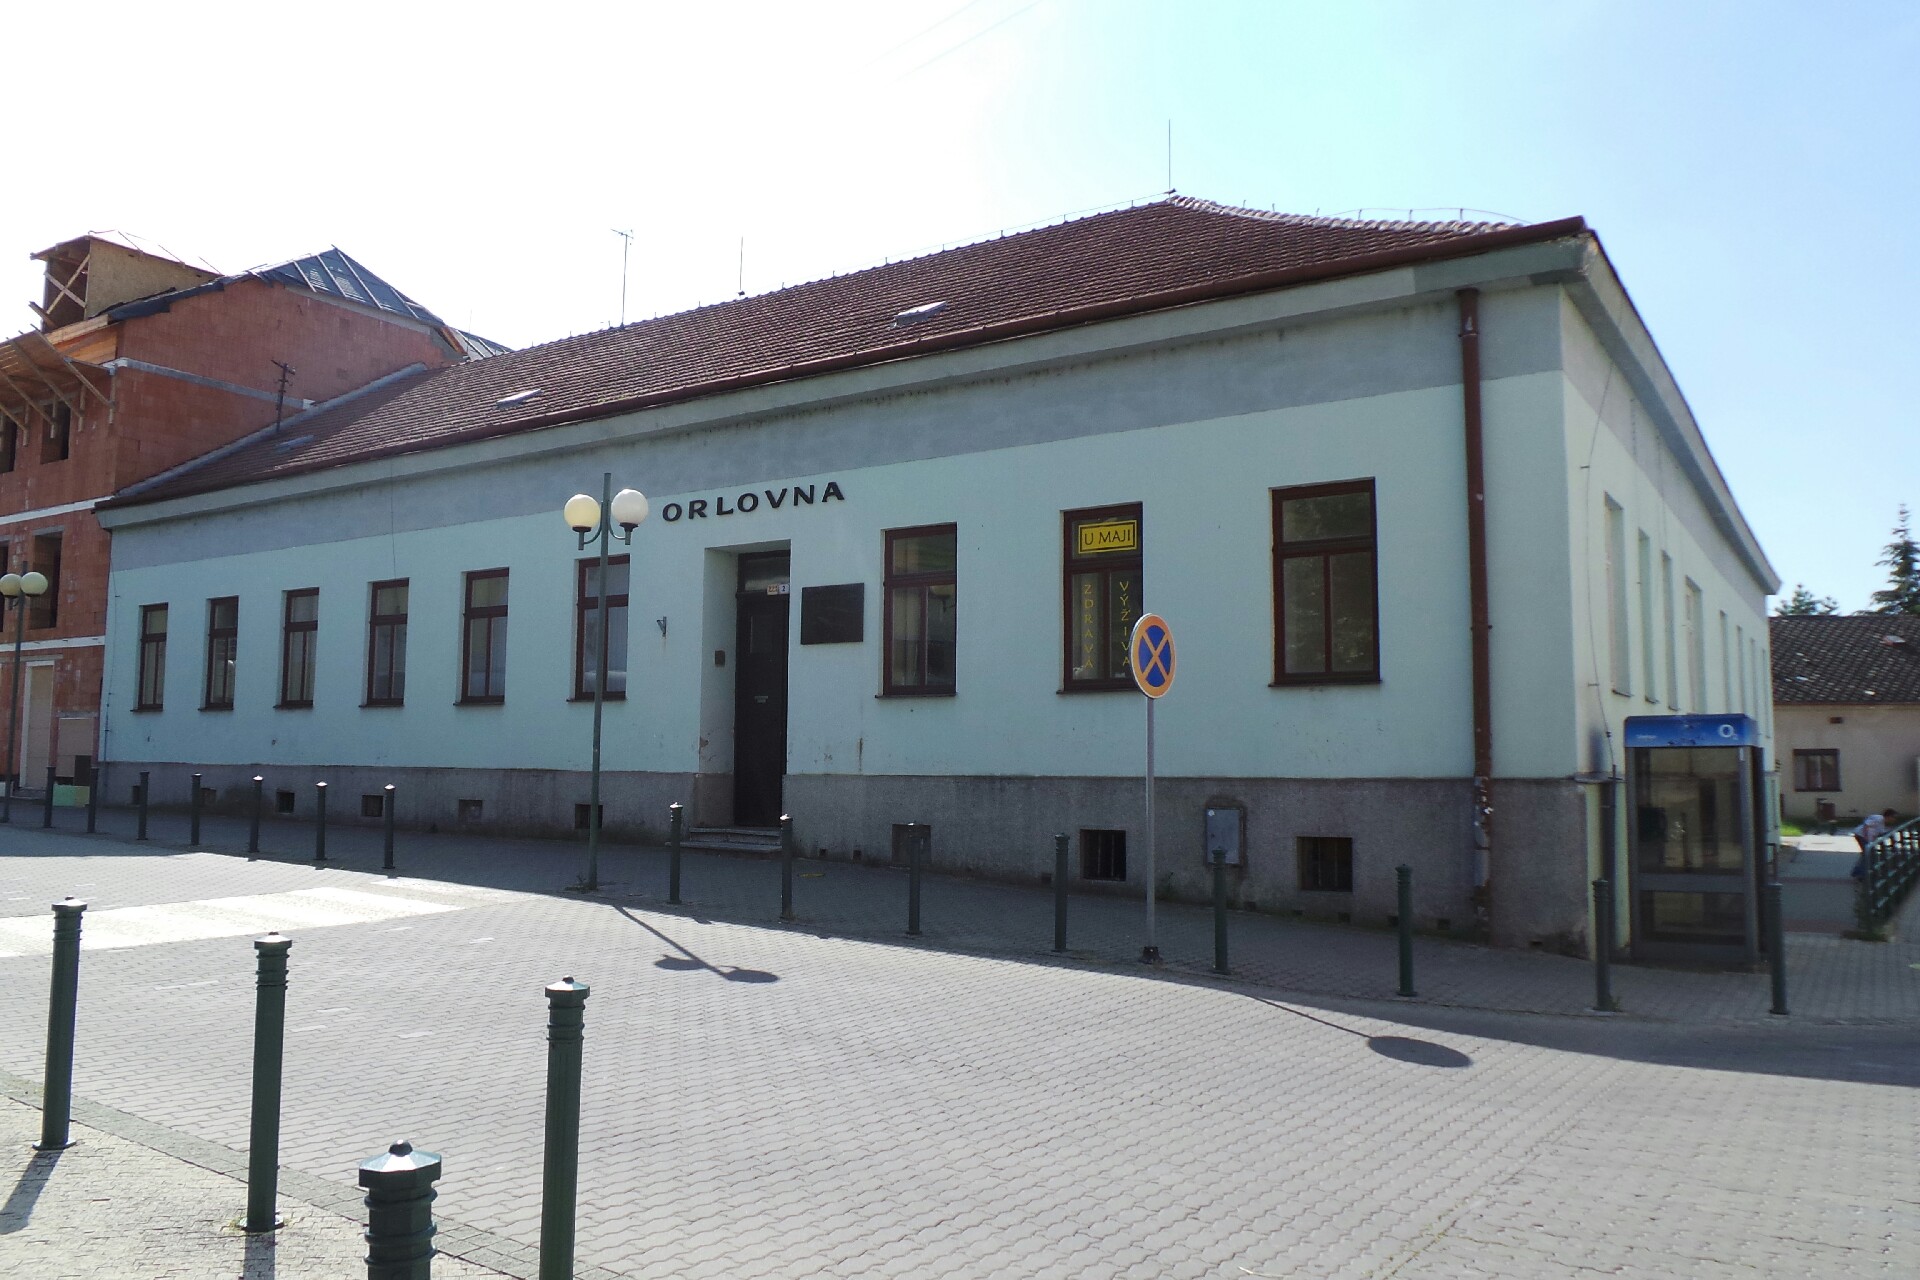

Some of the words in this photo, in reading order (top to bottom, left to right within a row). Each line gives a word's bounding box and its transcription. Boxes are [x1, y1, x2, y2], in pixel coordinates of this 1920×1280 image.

[662, 481, 845, 522] ORLOVNA
[1084, 532, 1094, 546] U
[1098, 529, 1131, 544] MAJI
